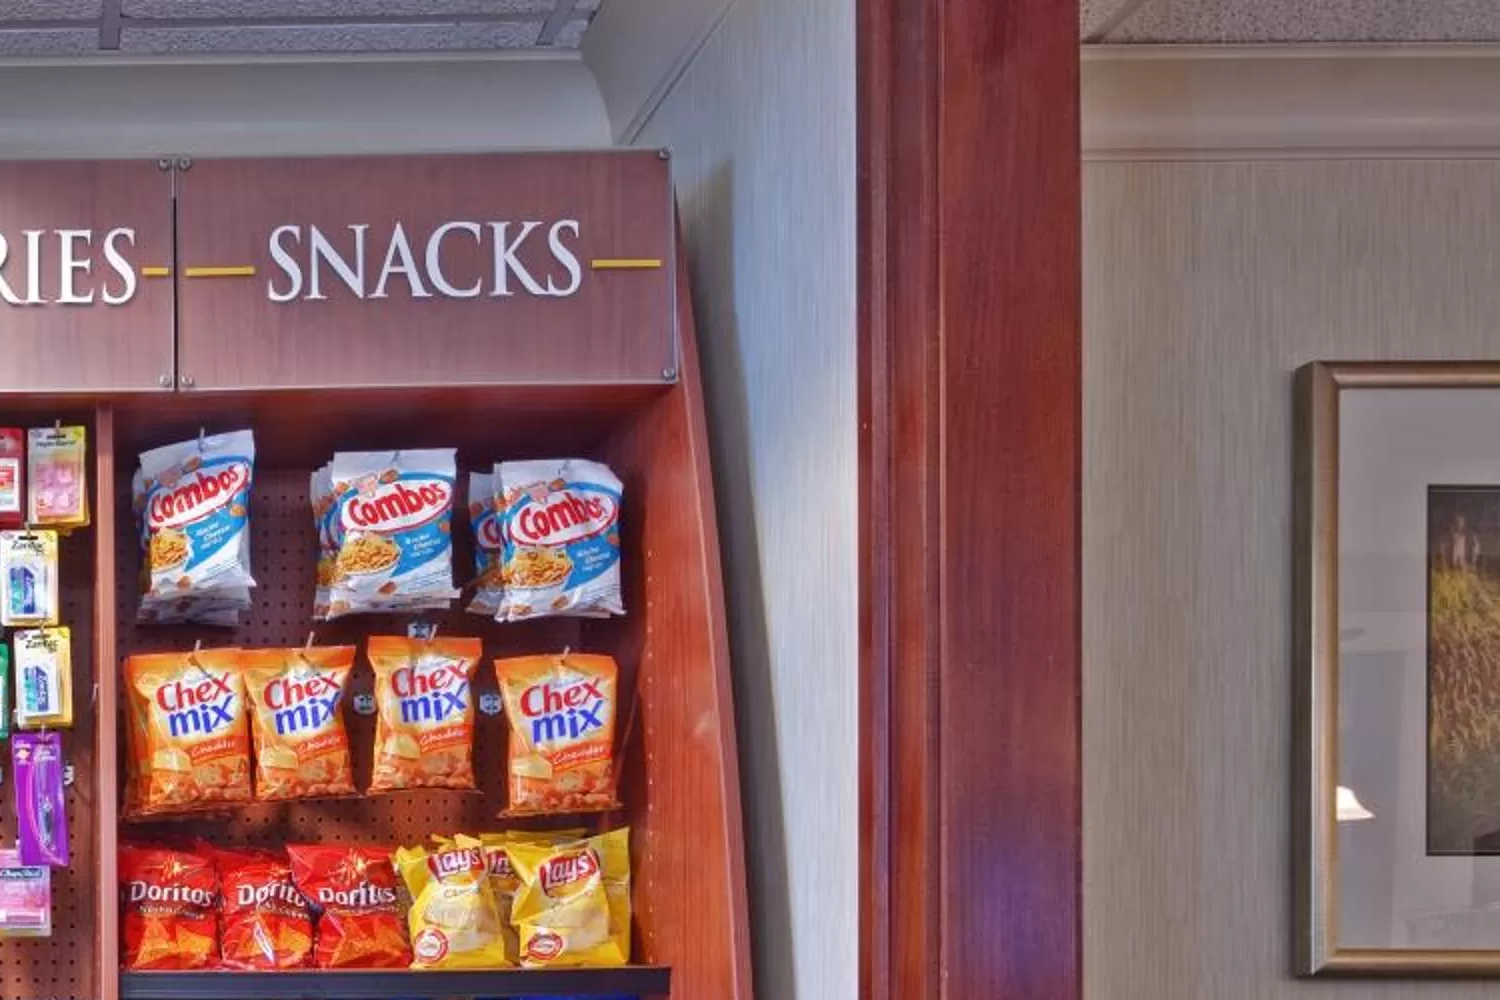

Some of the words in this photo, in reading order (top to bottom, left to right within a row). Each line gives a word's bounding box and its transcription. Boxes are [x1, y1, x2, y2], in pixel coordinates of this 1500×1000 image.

[267, 219, 582, 302] SNACKS
[150, 466, 238, 523] Combos
[350, 481, 447, 527] Combos
[156, 671, 234, 713] Chex
[263, 671, 341, 711] Chex
[391, 659, 469, 698] Chex
[520, 677, 604, 717] Chex
[168, 695, 235, 737] mix
[275, 691, 341, 736] mix
[401, 681, 468, 723] mix
[532, 700, 604, 744] mix
[130, 881, 214, 907] Doritos
[238, 878, 307, 907] Dorito
